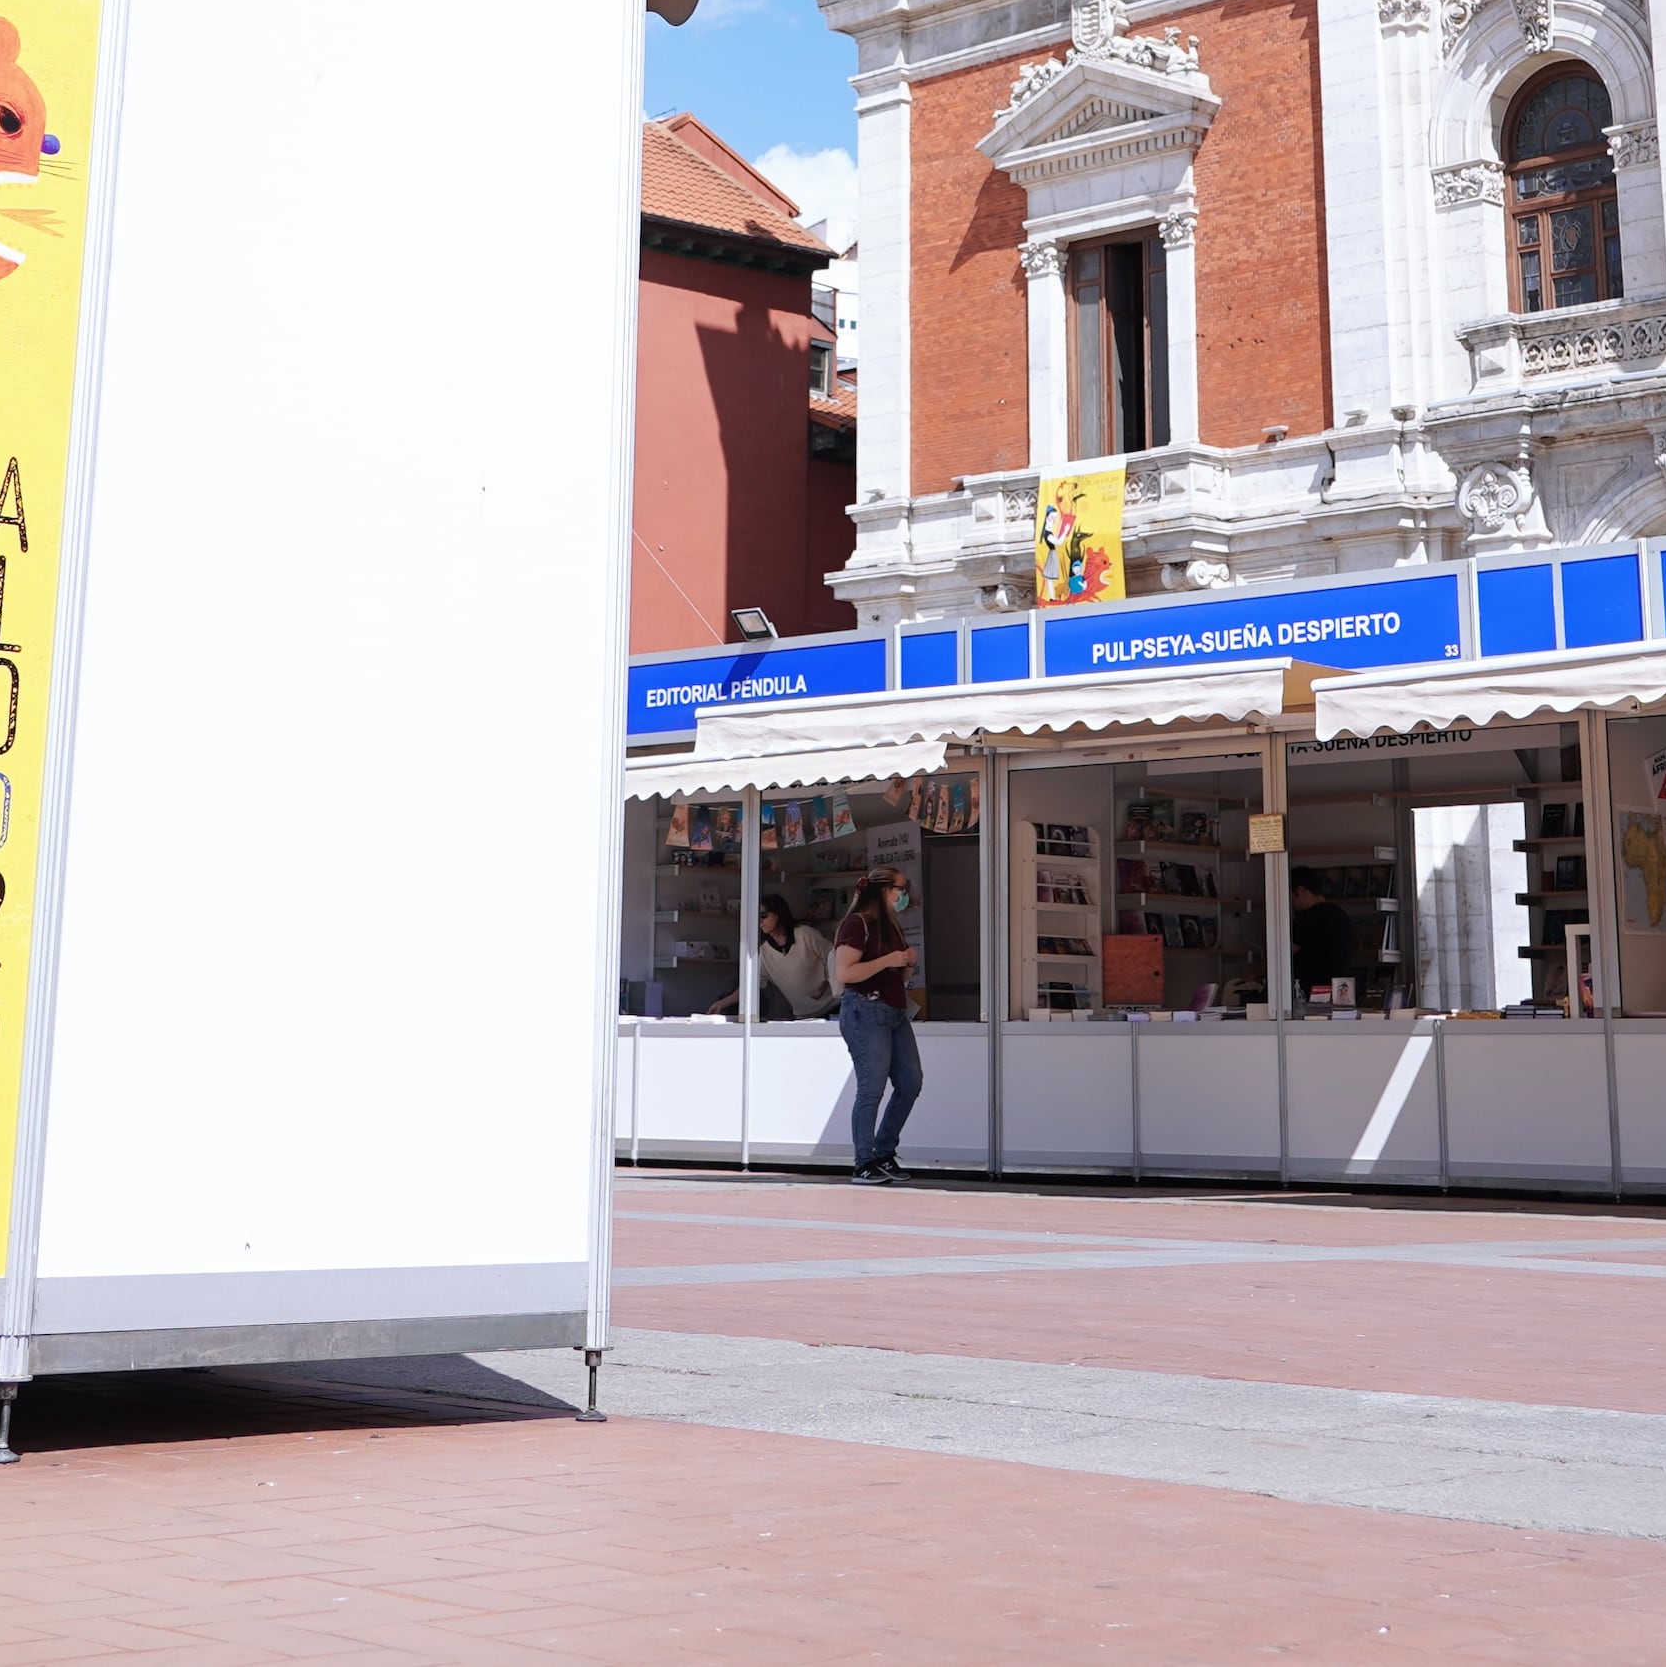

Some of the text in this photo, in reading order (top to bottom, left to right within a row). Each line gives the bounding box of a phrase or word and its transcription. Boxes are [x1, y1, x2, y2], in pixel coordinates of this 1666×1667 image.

[1092, 612, 1401, 665] PULPSEYA-SUEÑA DESPIERTO
[1444, 644, 1459, 658] 33
[646, 674, 808, 709] EDITORIAL PÉNDULA
